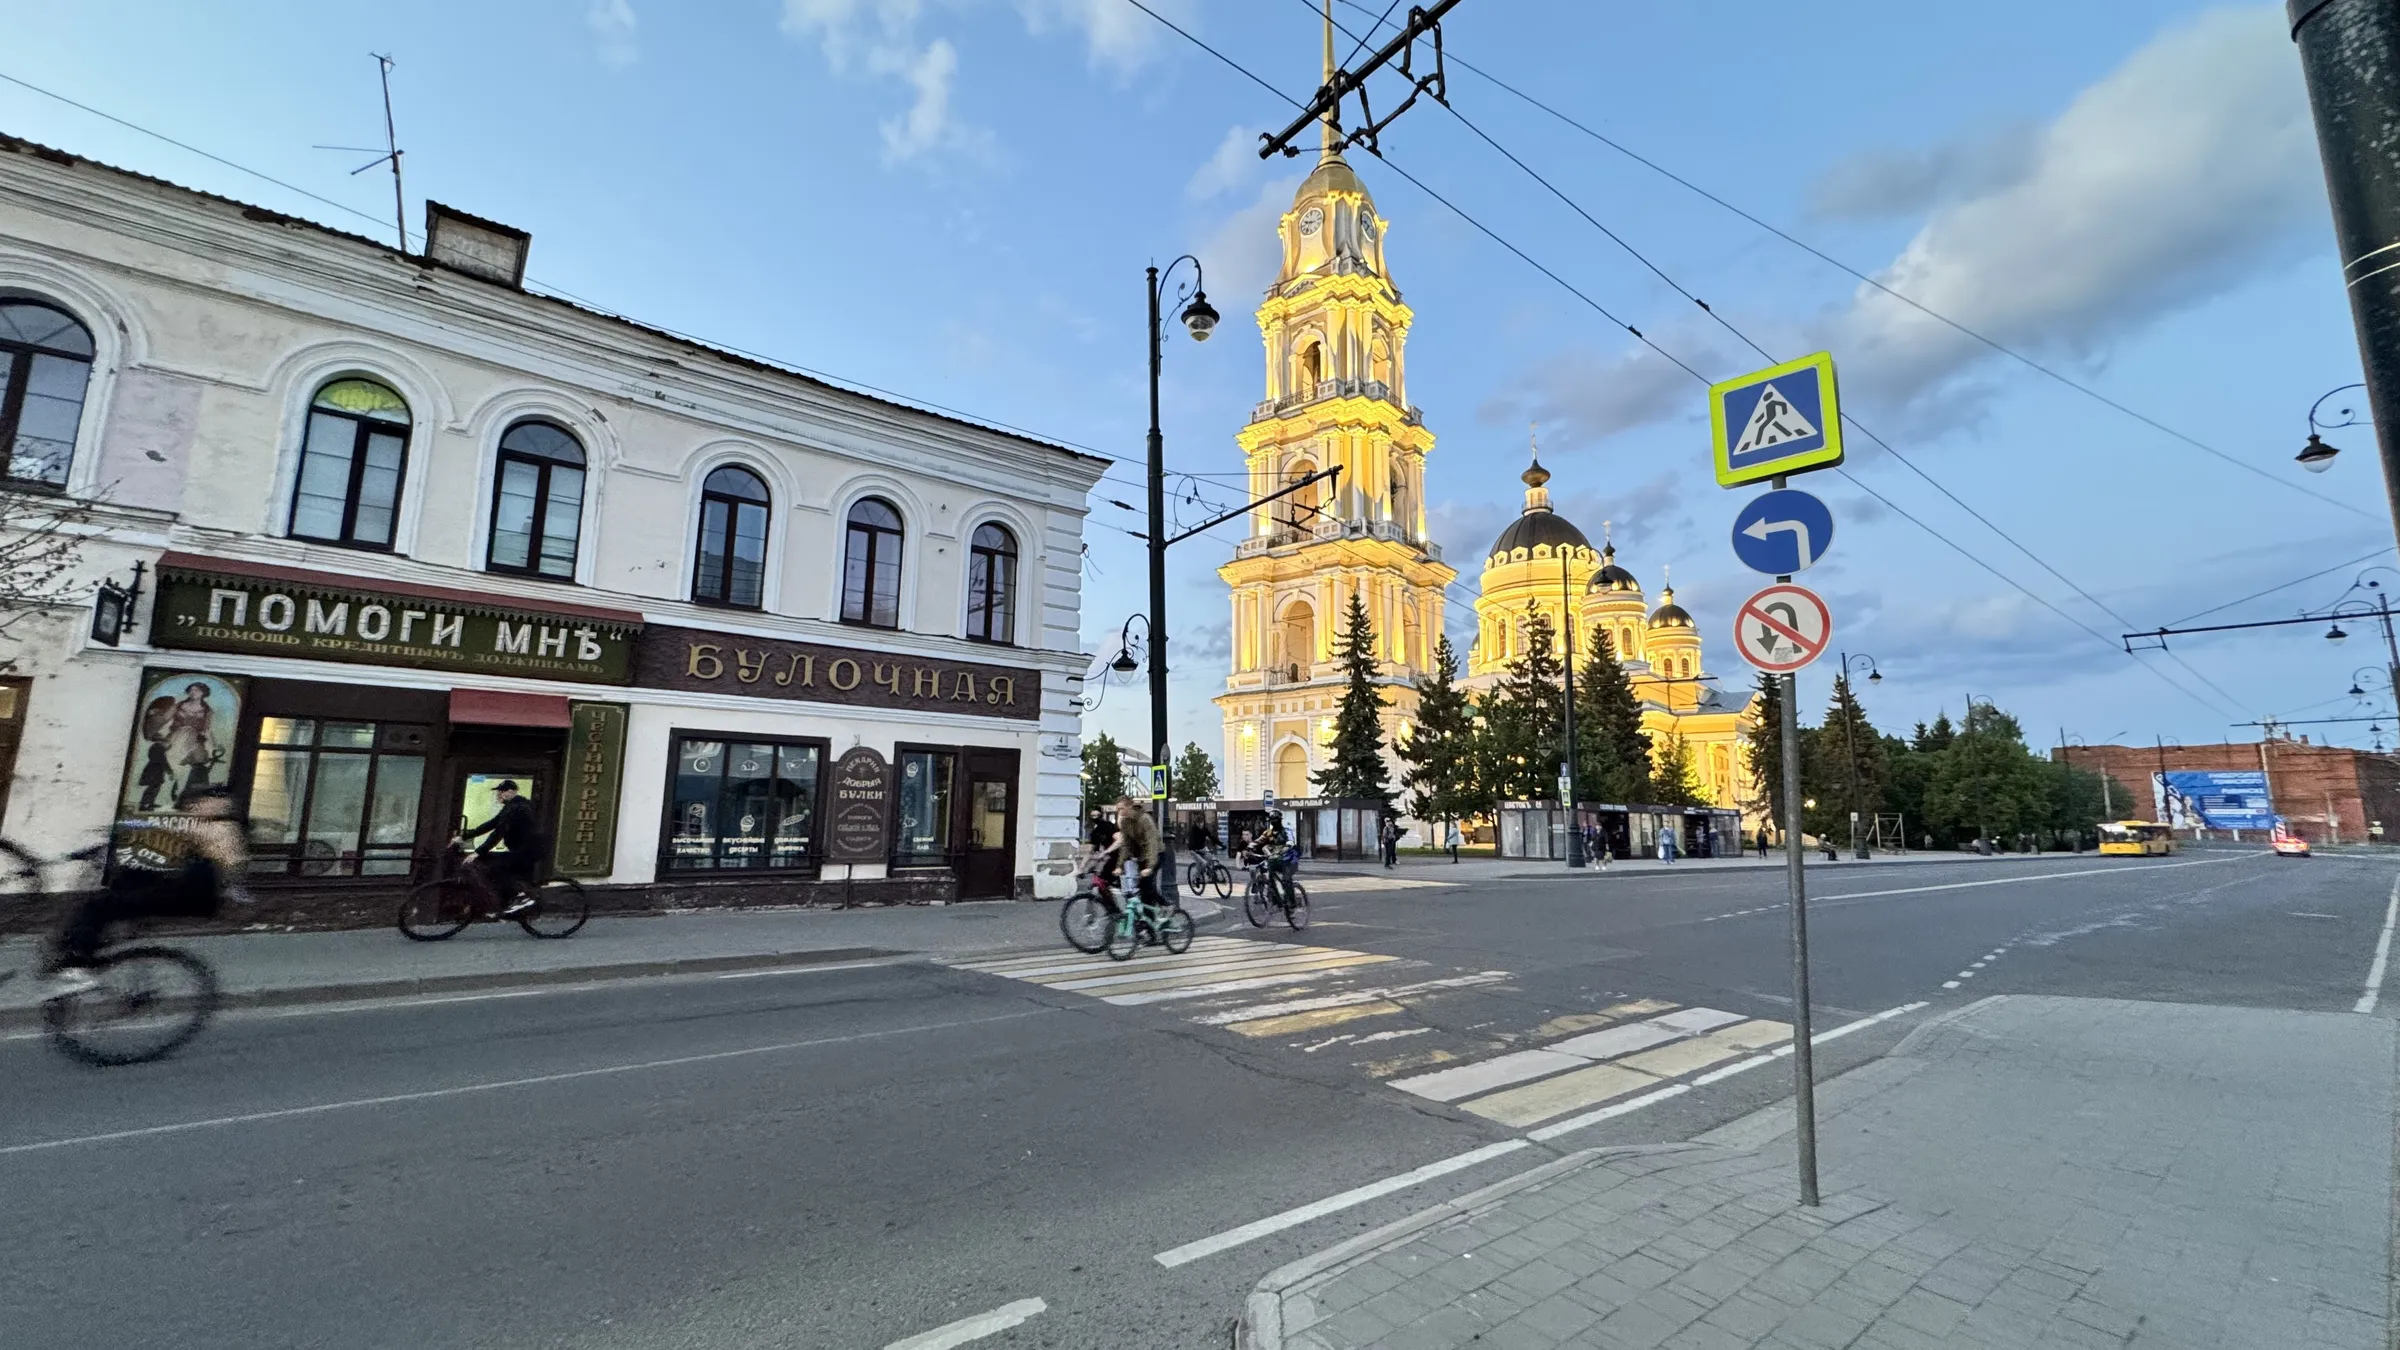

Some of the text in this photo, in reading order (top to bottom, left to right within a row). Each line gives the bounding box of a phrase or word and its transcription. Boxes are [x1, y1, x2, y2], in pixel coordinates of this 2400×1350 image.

[197, 626, 300, 645] ПОМОЩЬ
[685, 642, 1016, 706] БУЛОЧНАЯ
[846, 756, 880, 773] ПЕКАРНЯ
